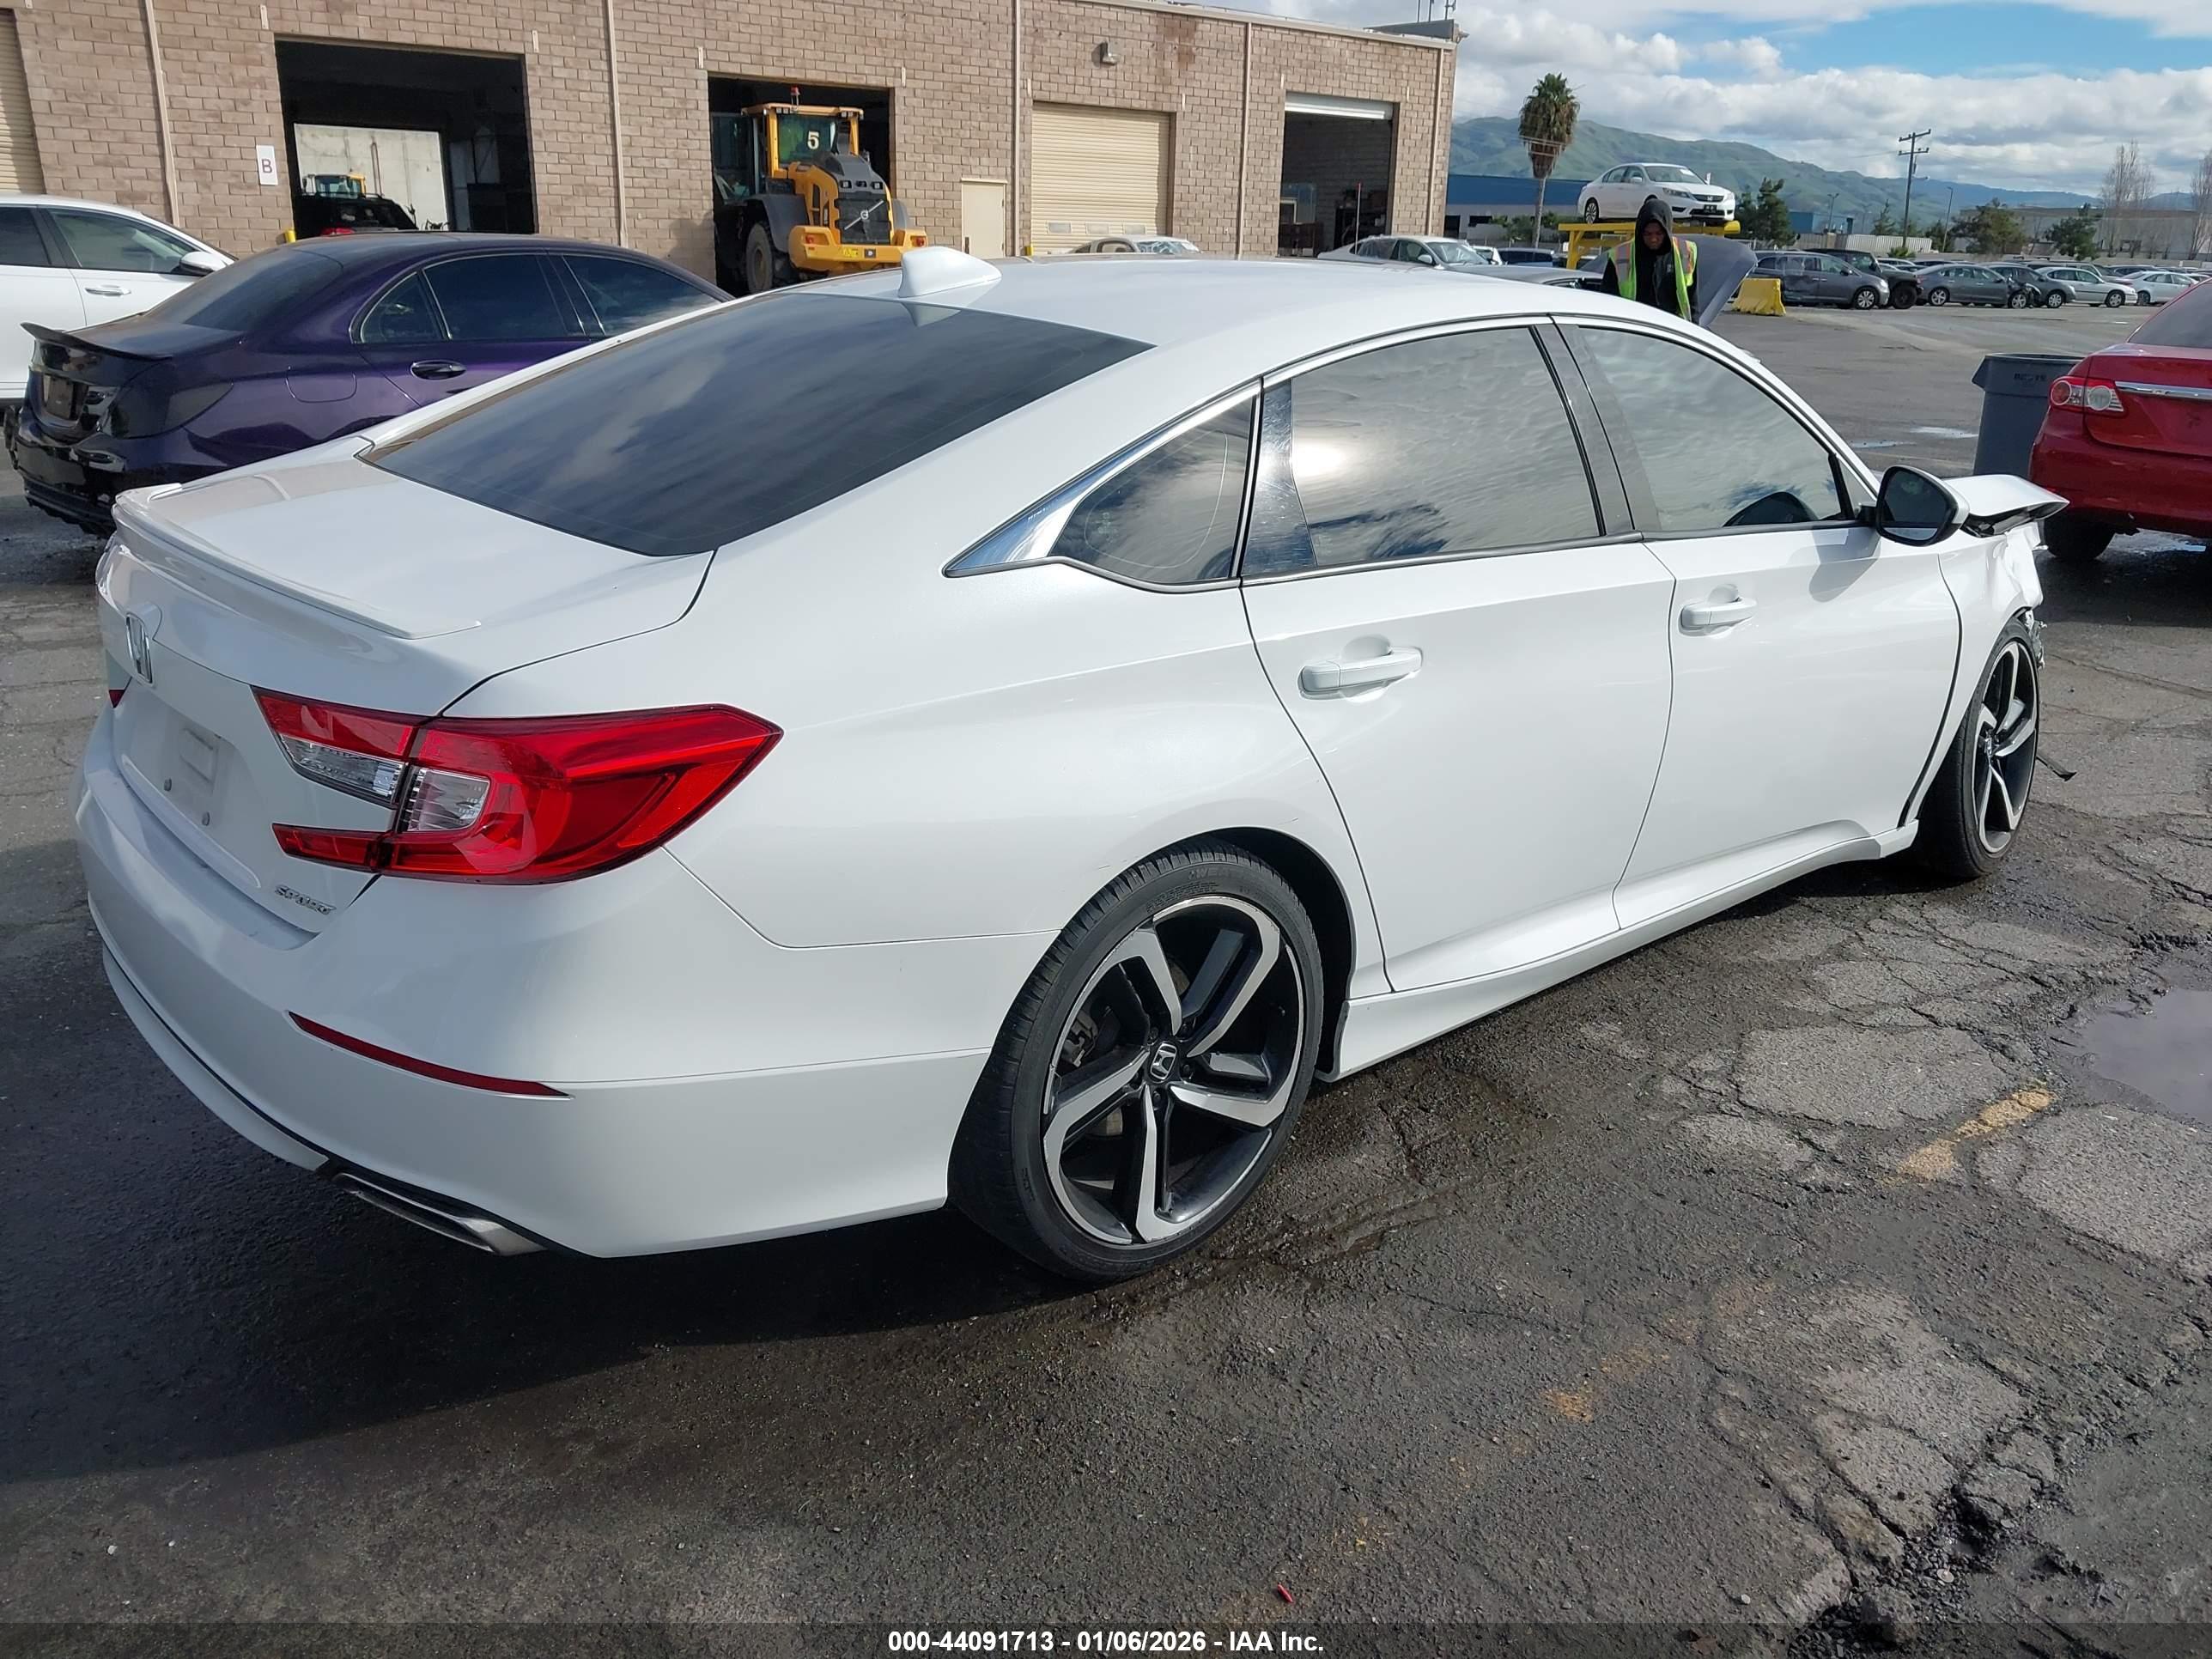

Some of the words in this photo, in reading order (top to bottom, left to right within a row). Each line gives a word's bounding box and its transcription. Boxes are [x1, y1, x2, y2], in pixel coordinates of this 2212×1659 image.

[807, 131, 820, 149] 5
[261, 158, 273, 173] B
[275, 884, 337, 915] SPORT
